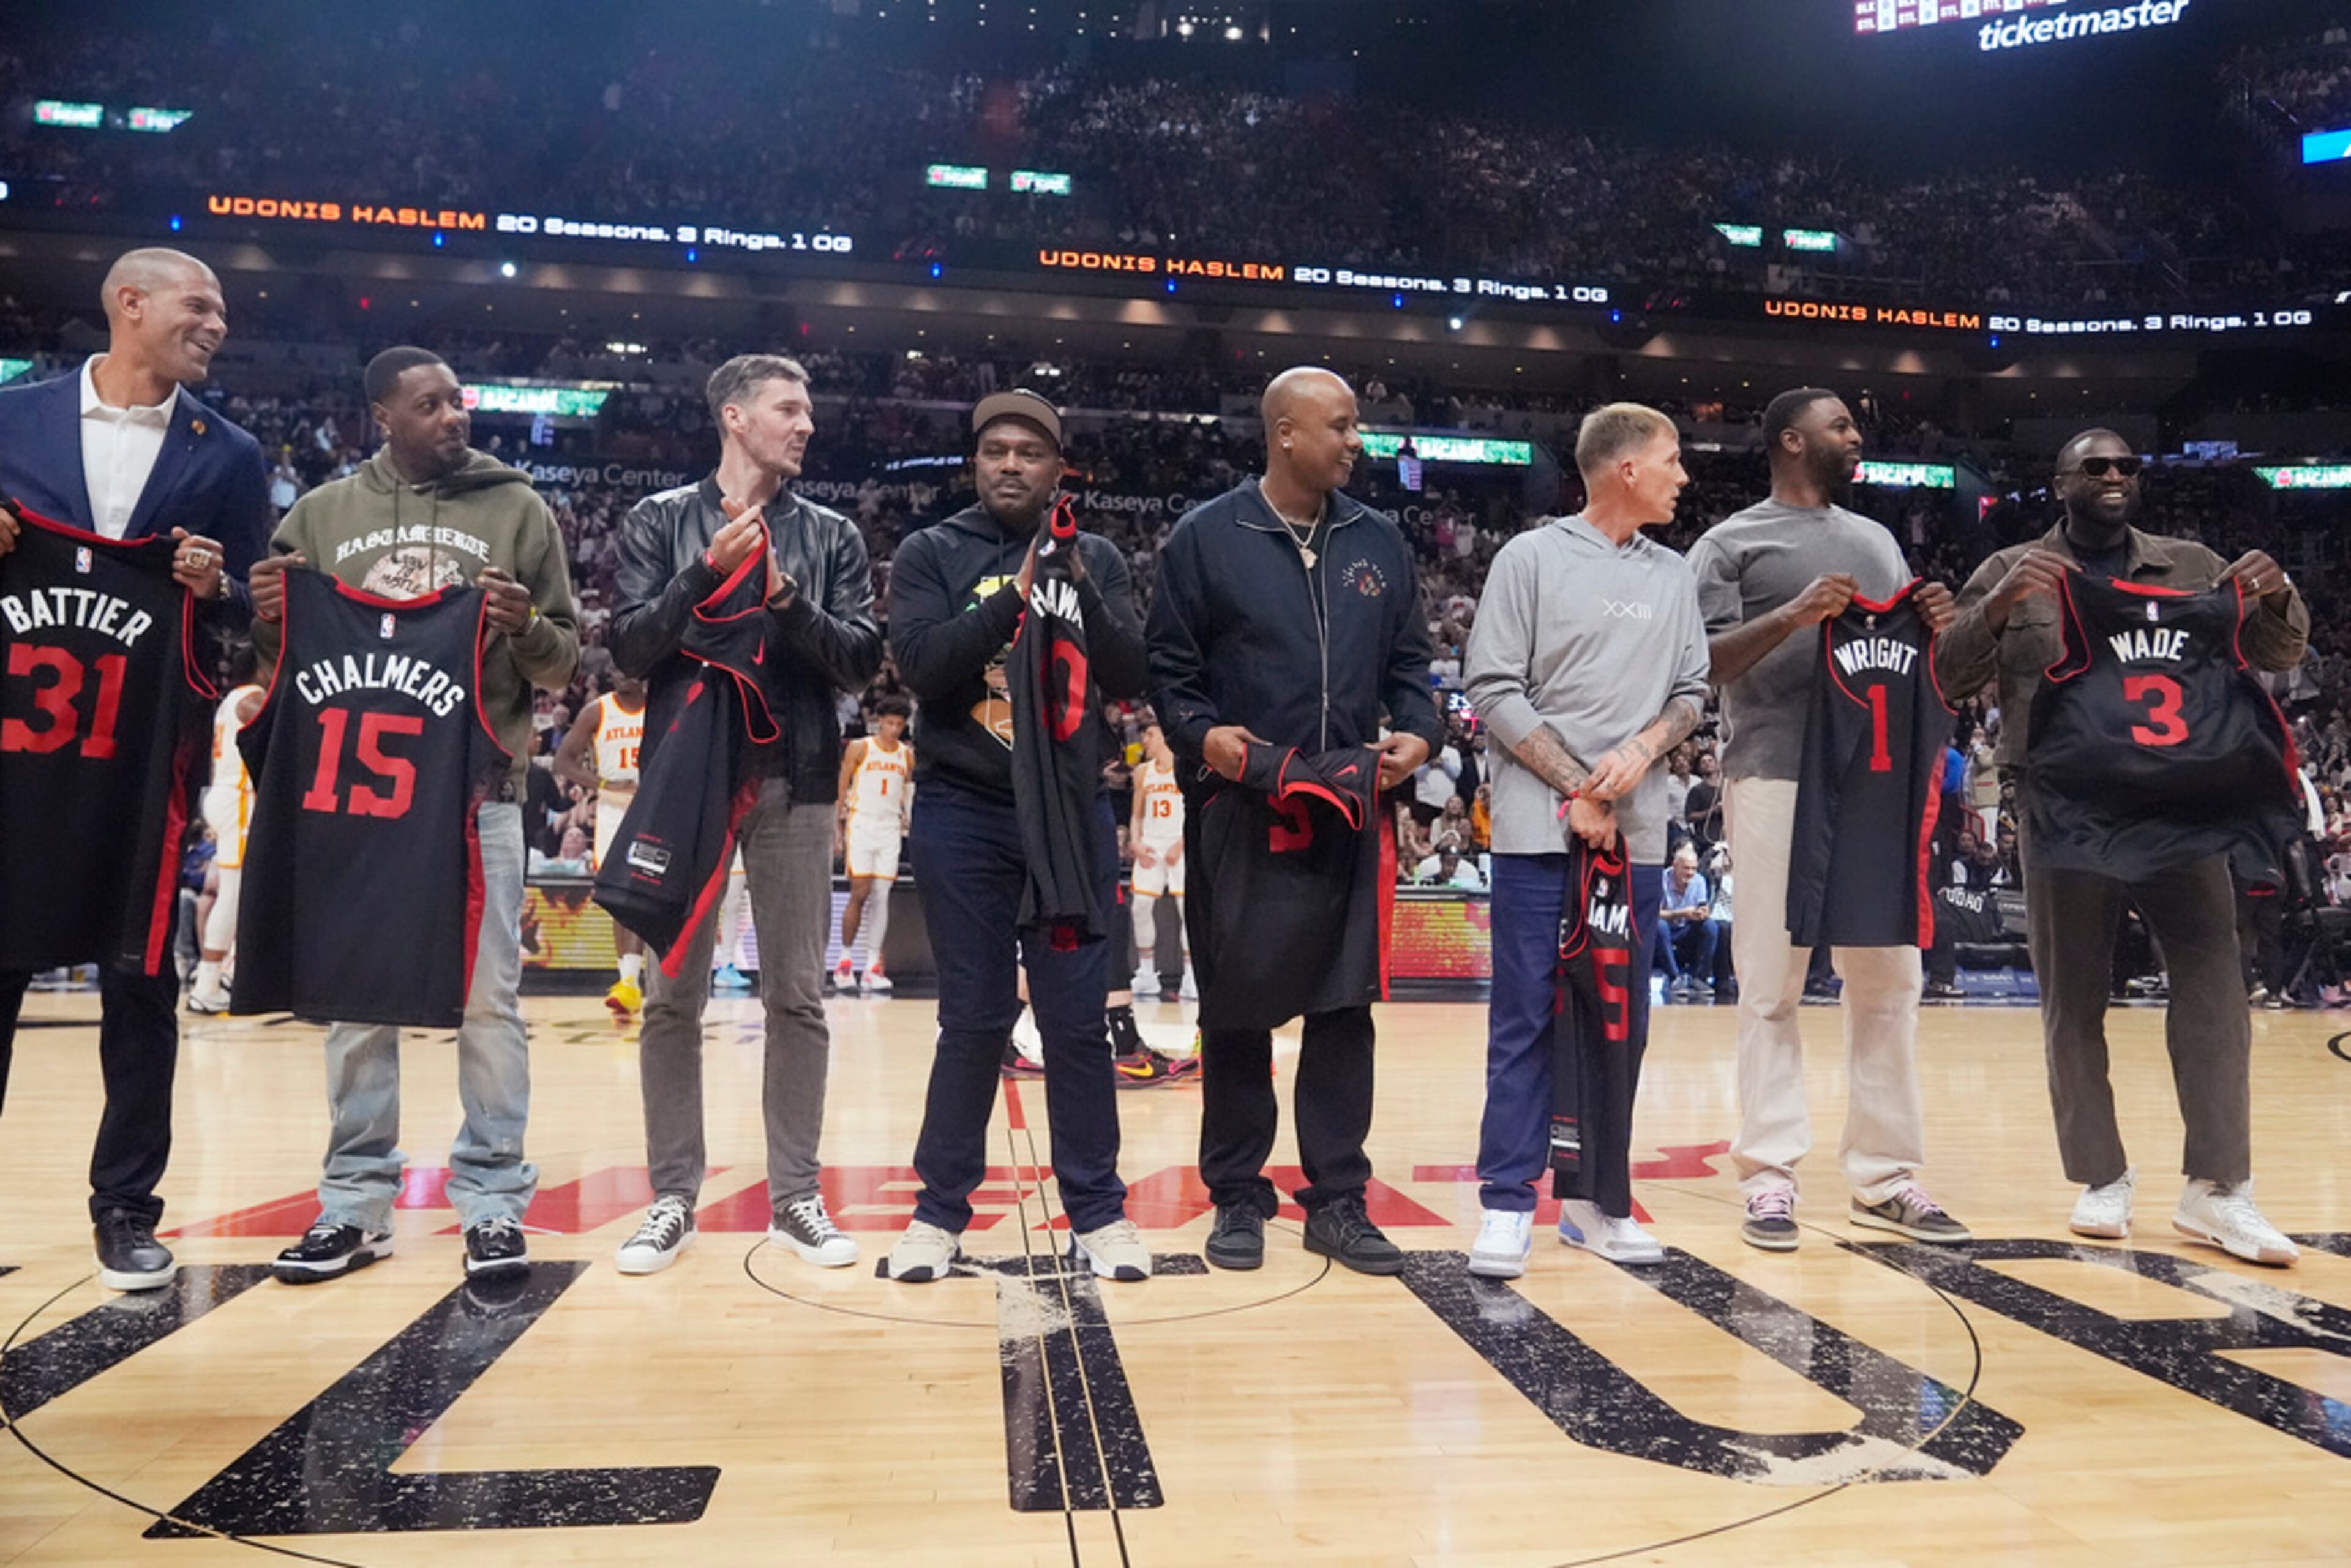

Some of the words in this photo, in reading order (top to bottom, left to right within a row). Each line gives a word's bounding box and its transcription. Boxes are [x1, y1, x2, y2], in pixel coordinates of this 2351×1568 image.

[1978, 0, 2189, 51] ticketmaster
[208, 195, 342, 221] UDONIS
[352, 205, 486, 230] HASLEM
[496, 214, 538, 233] 20
[544, 217, 671, 241] Seasons.
[677, 227, 697, 243] 3
[704, 227, 786, 250] Rings.
[792, 233, 807, 250] 1
[812, 234, 853, 252] OG
[1039, 250, 1157, 273] UDONIS
[1166, 258, 1284, 281] HASLEM
[1294, 266, 1330, 283] 20
[1335, 270, 1448, 292] Seasons.
[1453, 278, 1472, 293] 3
[1477, 279, 1550, 300] Rings.
[1555, 285, 1569, 300] 1
[1573, 287, 1608, 302] OG
[1765, 300, 1868, 321] UDONIS
[1877, 308, 1980, 329] HASLEM
[1989, 316, 2021, 331] 20
[2025, 318, 2139, 333] Seasons.
[2143, 316, 2164, 331] 3
[2170, 314, 2248, 332] Rings.
[2253, 312, 2268, 328] 1
[2273, 310, 2312, 326] OG
[515, 460, 599, 487] Kaseya
[603, 463, 688, 488] Center
[1084, 490, 1163, 514] Kaseya
[0, 587, 153, 648] BATTIER
[1834, 637, 1919, 677] WRIGHT
[2108, 627, 2191, 664] WADE
[0, 642, 127, 759] 31
[294, 652, 466, 718] CHALMERS
[2122, 673, 2190, 746] 3
[1867, 683, 1893, 772] 1
[302, 707, 424, 819] 15
[880, 778, 888, 797] 1
[1152, 798, 1172, 818] 13
